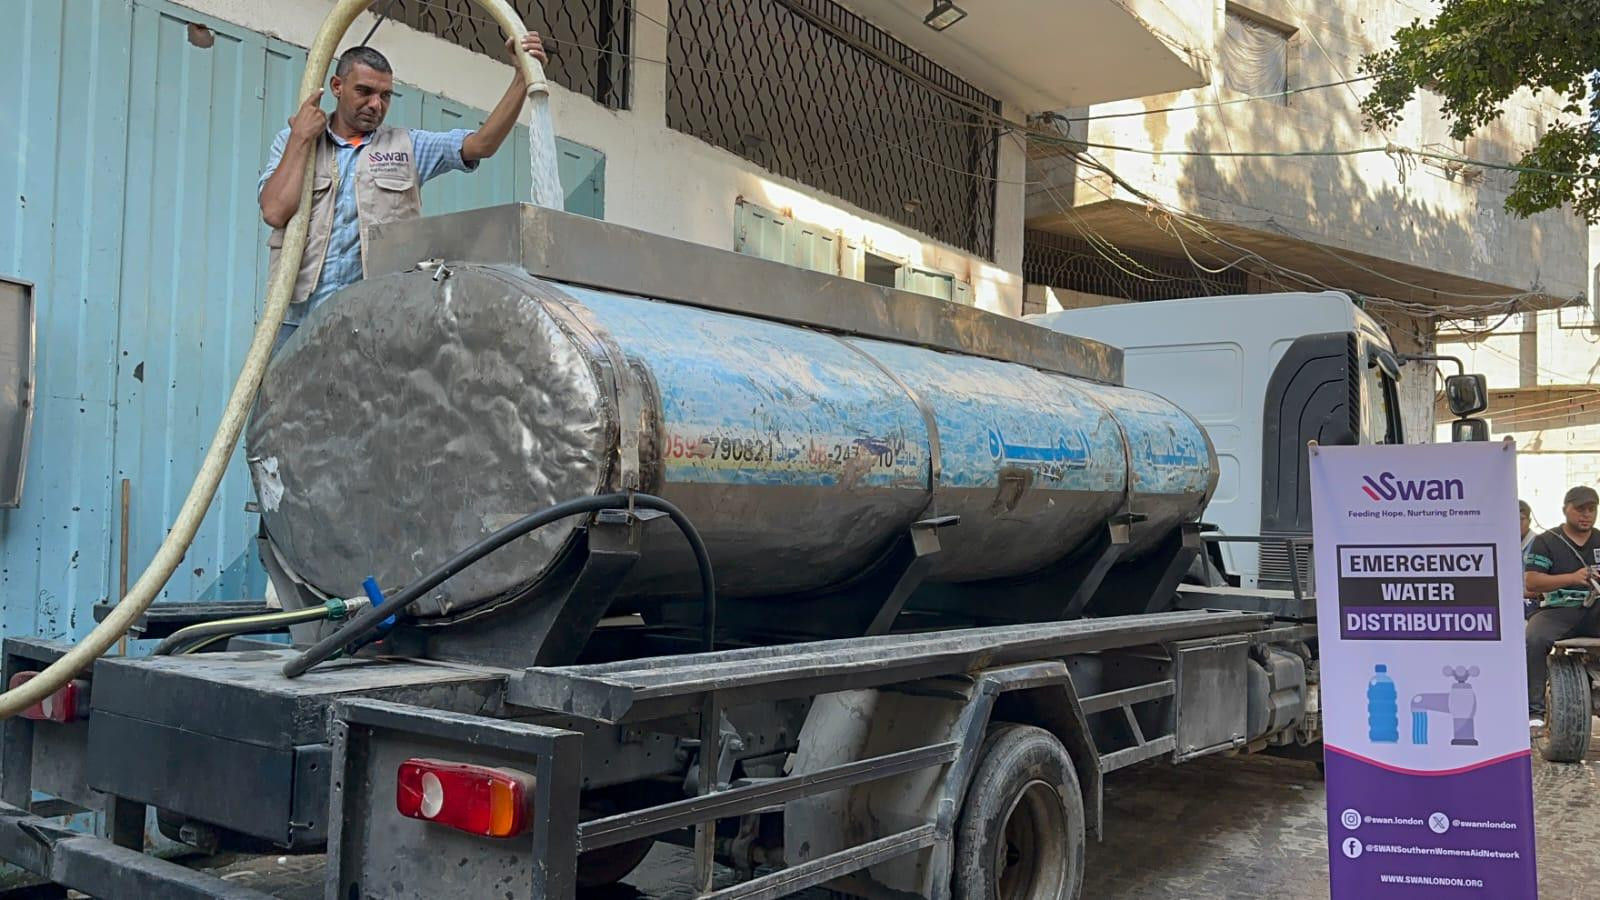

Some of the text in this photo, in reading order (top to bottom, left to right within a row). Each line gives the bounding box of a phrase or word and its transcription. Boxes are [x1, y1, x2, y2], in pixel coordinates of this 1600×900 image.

[368, 151, 409, 162] Swan
[1362, 471, 1464, 501] Swan
[1348, 510, 1380, 519] Feeding
[1407, 509, 1447, 518] Nurturing
[1449, 508, 1481, 516] Dreams
[1350, 554, 1484, 572] EMERGENCY
[1381, 583, 1455, 601] WATER
[1347, 613, 1493, 632] DISTRIBUTION
[1364, 815, 1424, 826] @swan.london
[1452, 819, 1517, 829] @swannlondon
[1365, 844, 1520, 859] @SWANSouthernWomensAidNetwork
[1380, 874, 1484, 887] WWW.SWANLONDON.ORG
